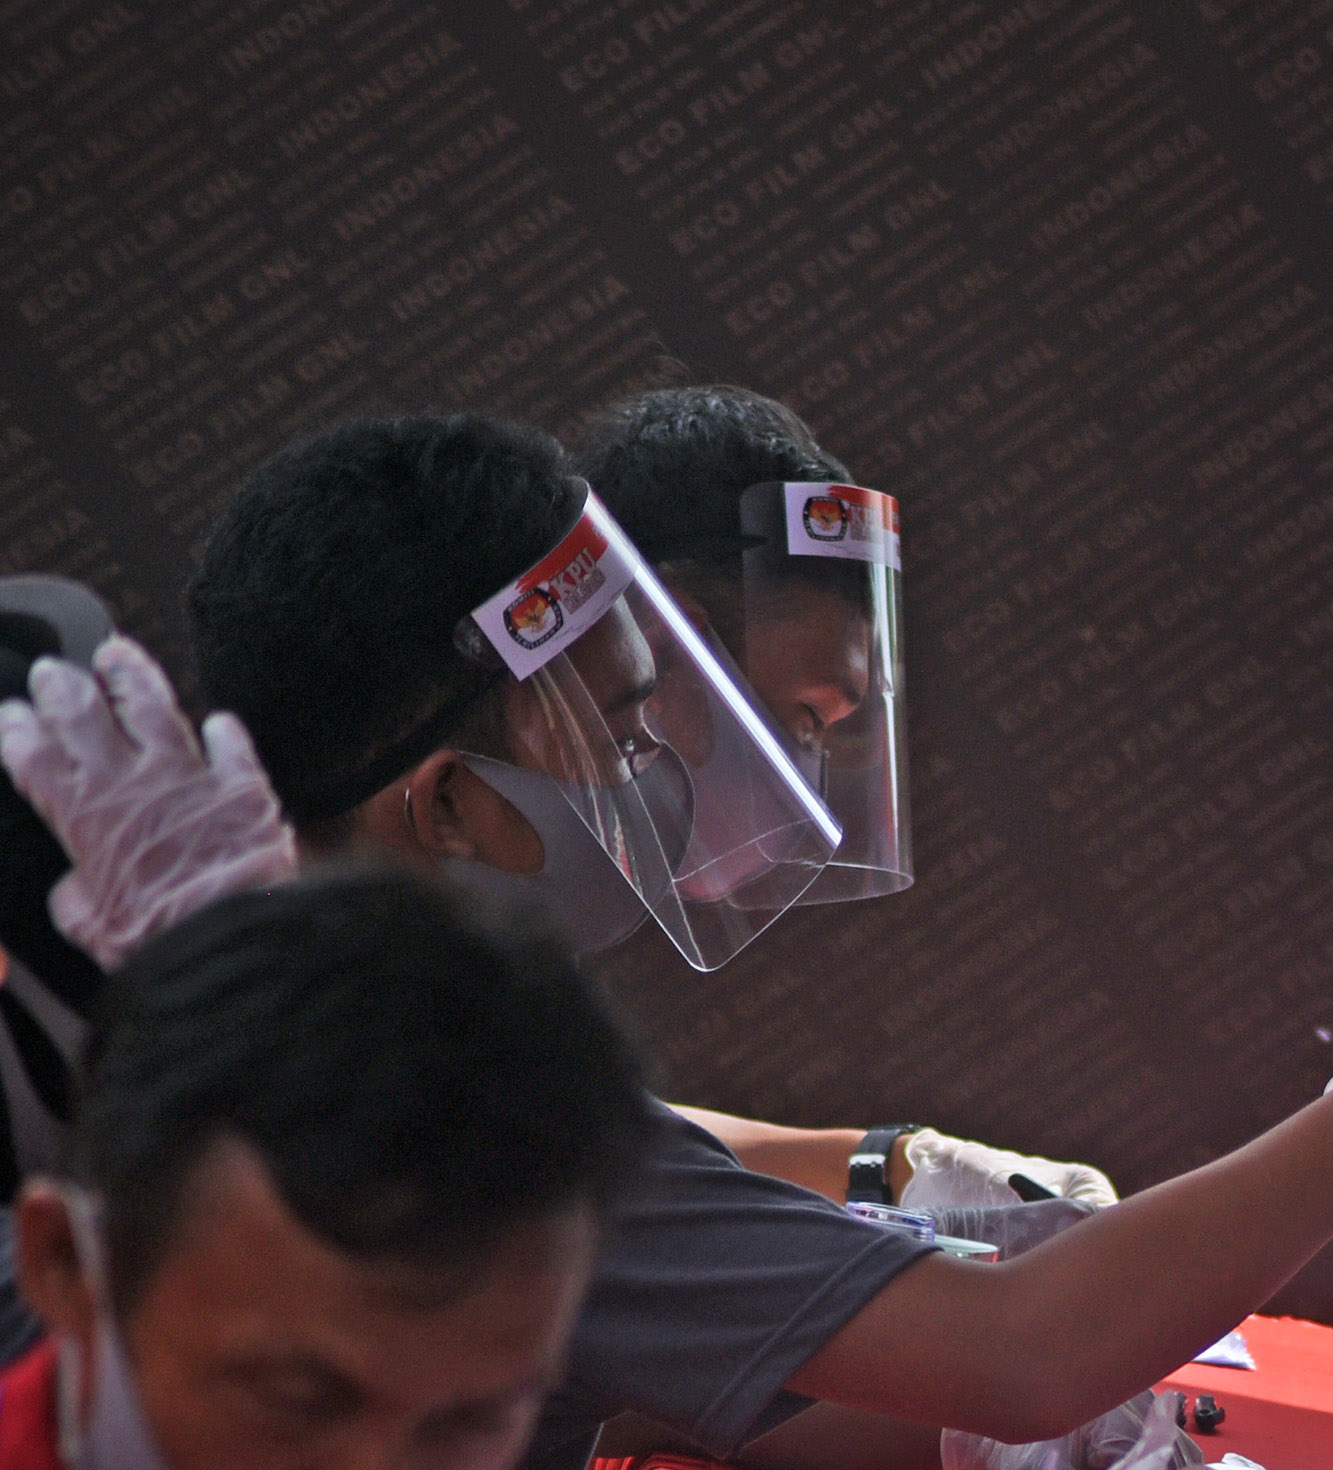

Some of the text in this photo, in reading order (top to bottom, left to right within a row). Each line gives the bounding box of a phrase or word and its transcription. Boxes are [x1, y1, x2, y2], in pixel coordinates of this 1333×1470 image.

[0, 48, 67, 104] ILM
[18, 27, 463, 326] ECO FILM GNL INDONESIA
[558, 35, 632, 94] ECO
[613, 116, 687, 175] ECO
[687, 60, 772, 126] FILM
[667, 197, 742, 255] ECO
[742, 141, 826, 207] FILM
[920, 0, 1072, 89] INDONE
[722, 38, 1160, 336] ECO FILM GNL INDONESIA
[74, 109, 519, 407] ECO FILM GNL INDONESIA
[130, 190, 574, 488] ECO FILM GNL INDONESIA
[548, 546, 598, 602] KPU
